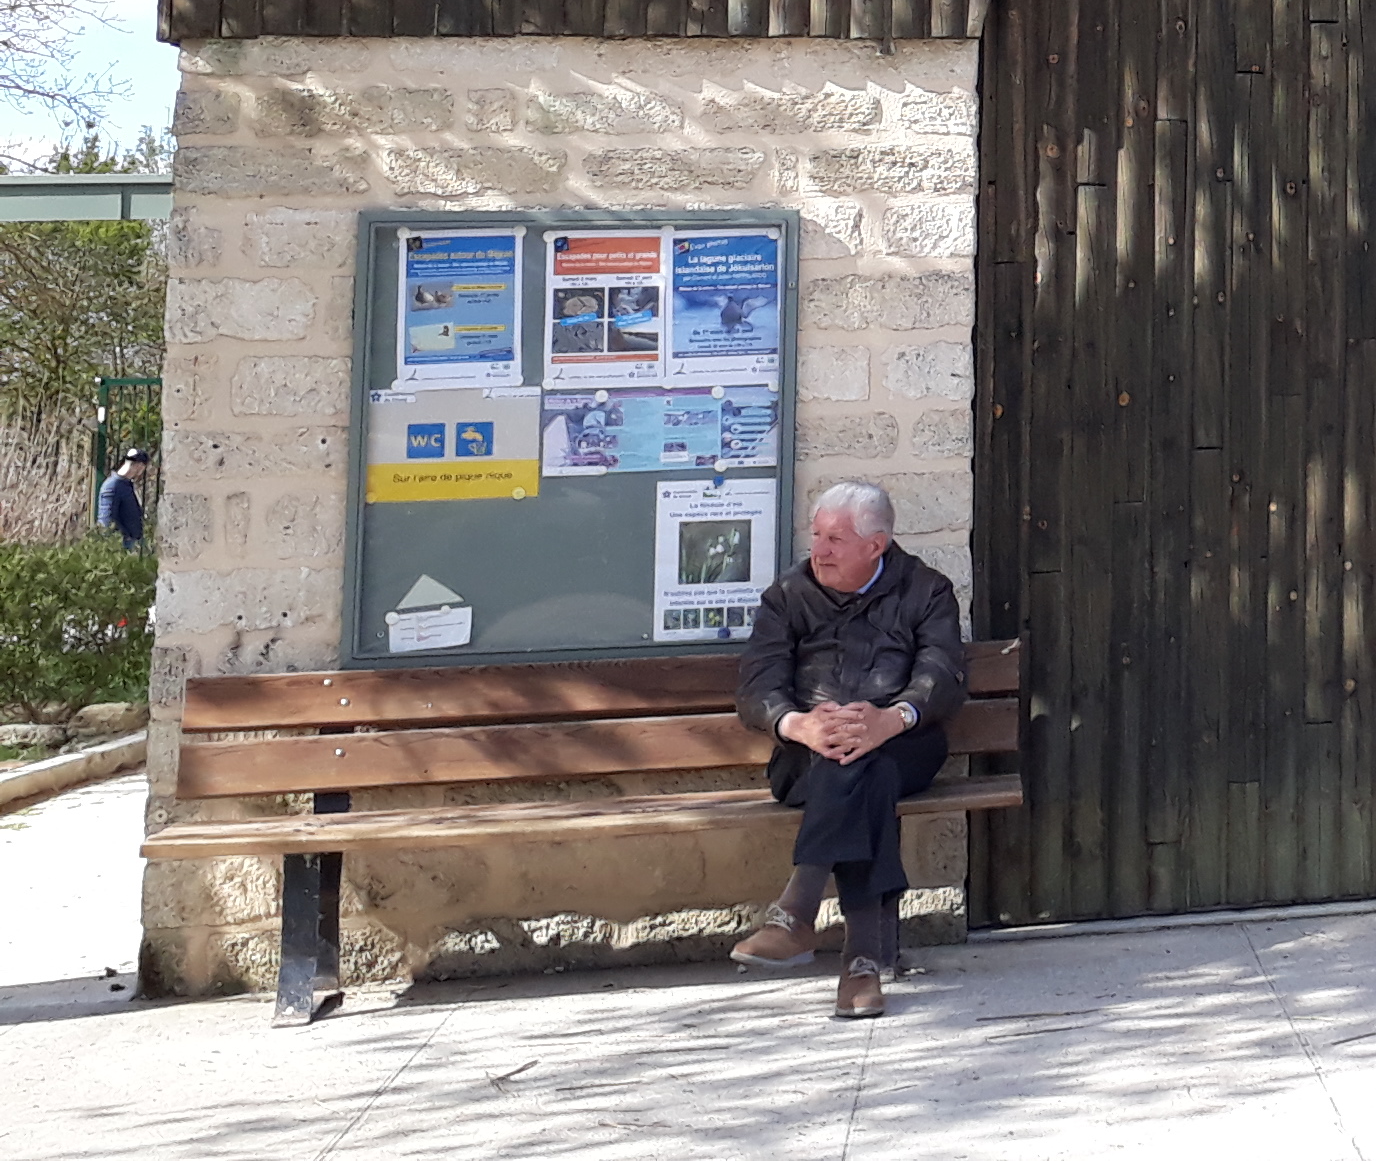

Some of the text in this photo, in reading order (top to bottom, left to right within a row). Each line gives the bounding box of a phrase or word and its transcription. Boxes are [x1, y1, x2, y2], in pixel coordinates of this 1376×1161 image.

[556, 252, 592, 261] Escapades
[608, 252, 626, 260] petits
[700, 255, 726, 265] lagune
[728, 254, 762, 264] glaciaire
[410, 434, 441, 447] WC
[392, 473, 411, 483] Sur
[440, 472, 453, 481] de
[455, 472, 483, 483] pique
[485, 471, 513, 481] nique
